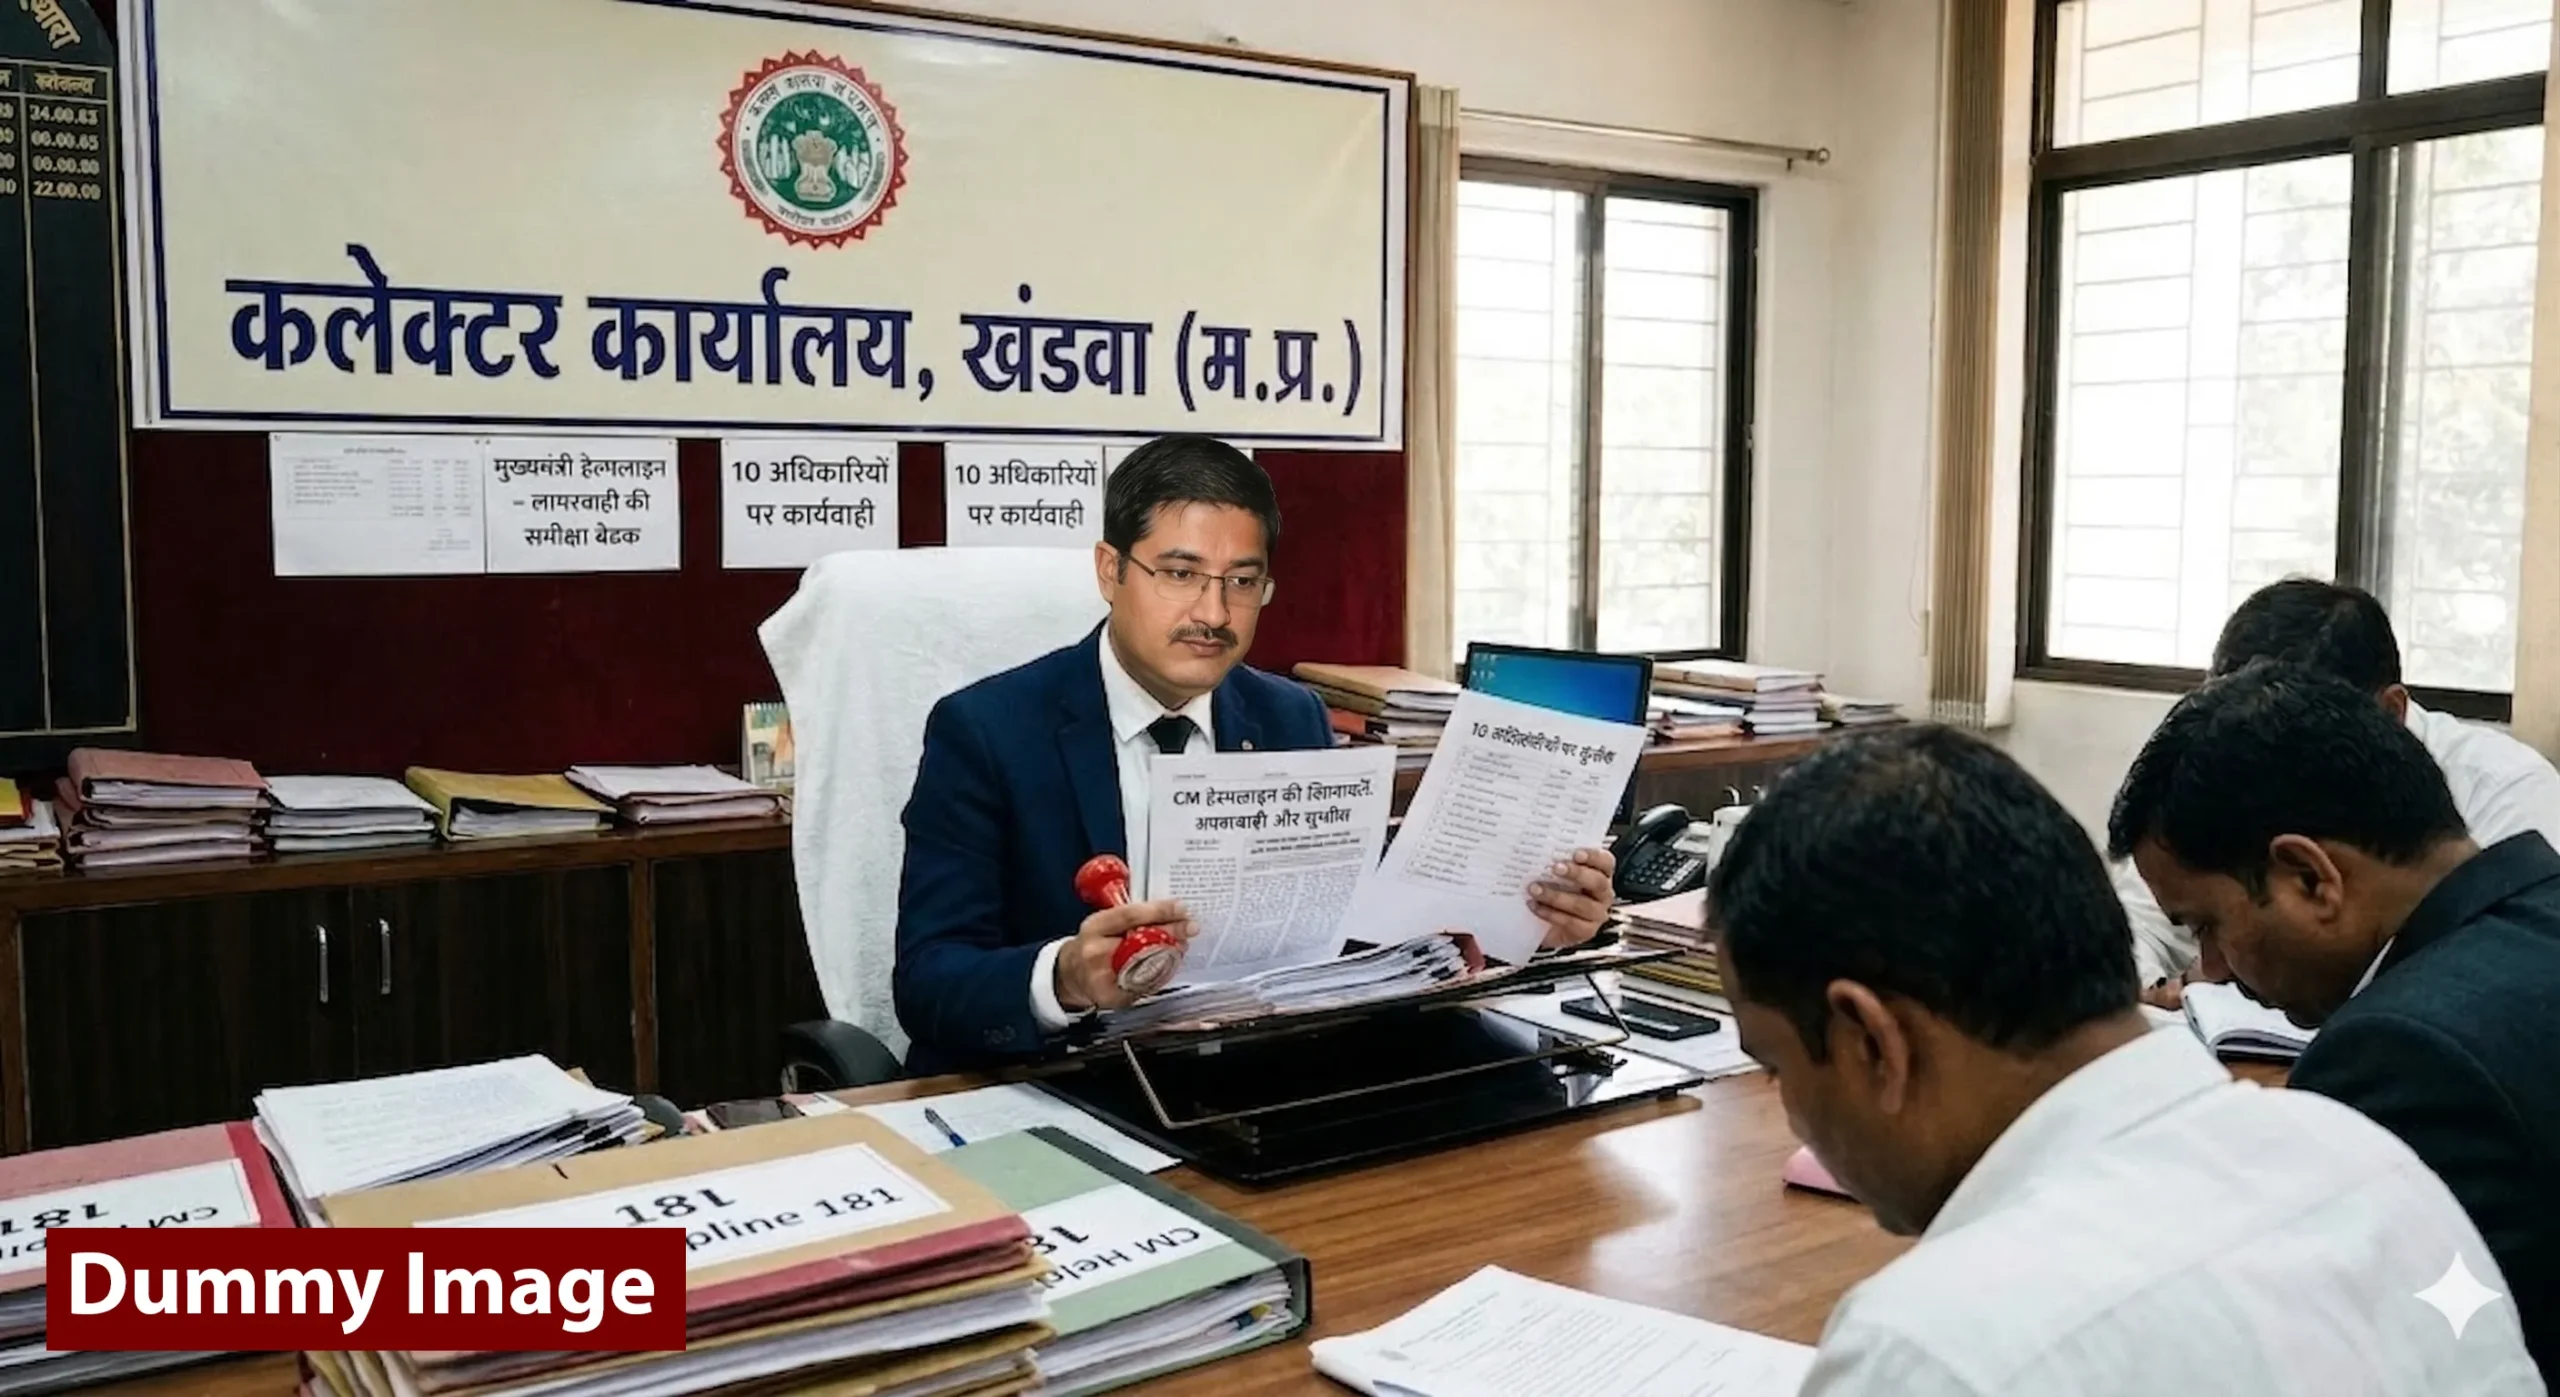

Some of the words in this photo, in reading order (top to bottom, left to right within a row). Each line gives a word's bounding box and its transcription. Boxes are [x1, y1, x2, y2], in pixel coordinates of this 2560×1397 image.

[225, 244, 563, 378] कलेक्टर
[588, 268, 936, 402] कार्यालय,
[959, 284, 1153, 396] खंडवा
[1175, 312, 1364, 410] (म.प्र.)
[732, 461, 761, 483] 10
[769, 455, 890, 484] अधिकारियों
[955, 464, 981, 485] 10
[988, 459, 1098, 486] अधिकारियों
[624, 488, 652, 512] की
[746, 504, 776, 526] पर
[781, 497, 876, 529] कार्यवाही
[967, 504, 995, 525] पर
[999, 498, 1085, 529] कार्यवाही
[1173, 789, 1200, 805] CM
[615, 1188, 736, 1226] 181
[685, 1211, 804, 1251] pline
[814, 1186, 904, 1217] 181
[1134, 1226, 1200, 1255] CM
